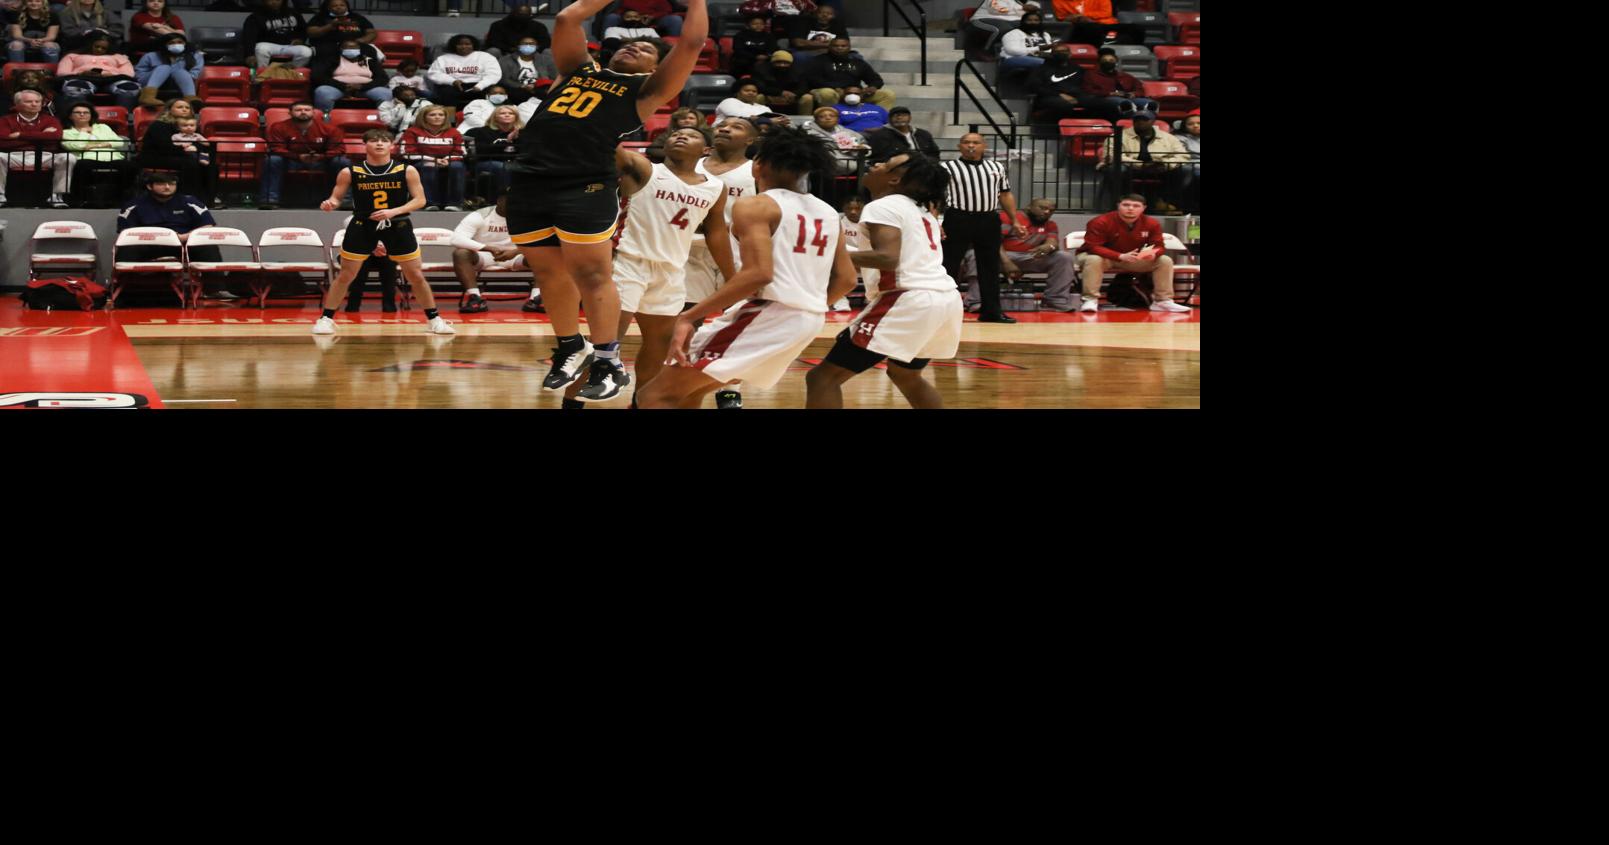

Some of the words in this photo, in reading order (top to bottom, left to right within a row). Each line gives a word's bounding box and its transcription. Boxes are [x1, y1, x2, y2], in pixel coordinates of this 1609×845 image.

[547, 86, 602, 118] 20
[357, 181, 402, 191] PRICEVILLE
[372, 190, 388, 209] 2
[670, 207, 689, 230] 4
[793, 214, 828, 257] 14
